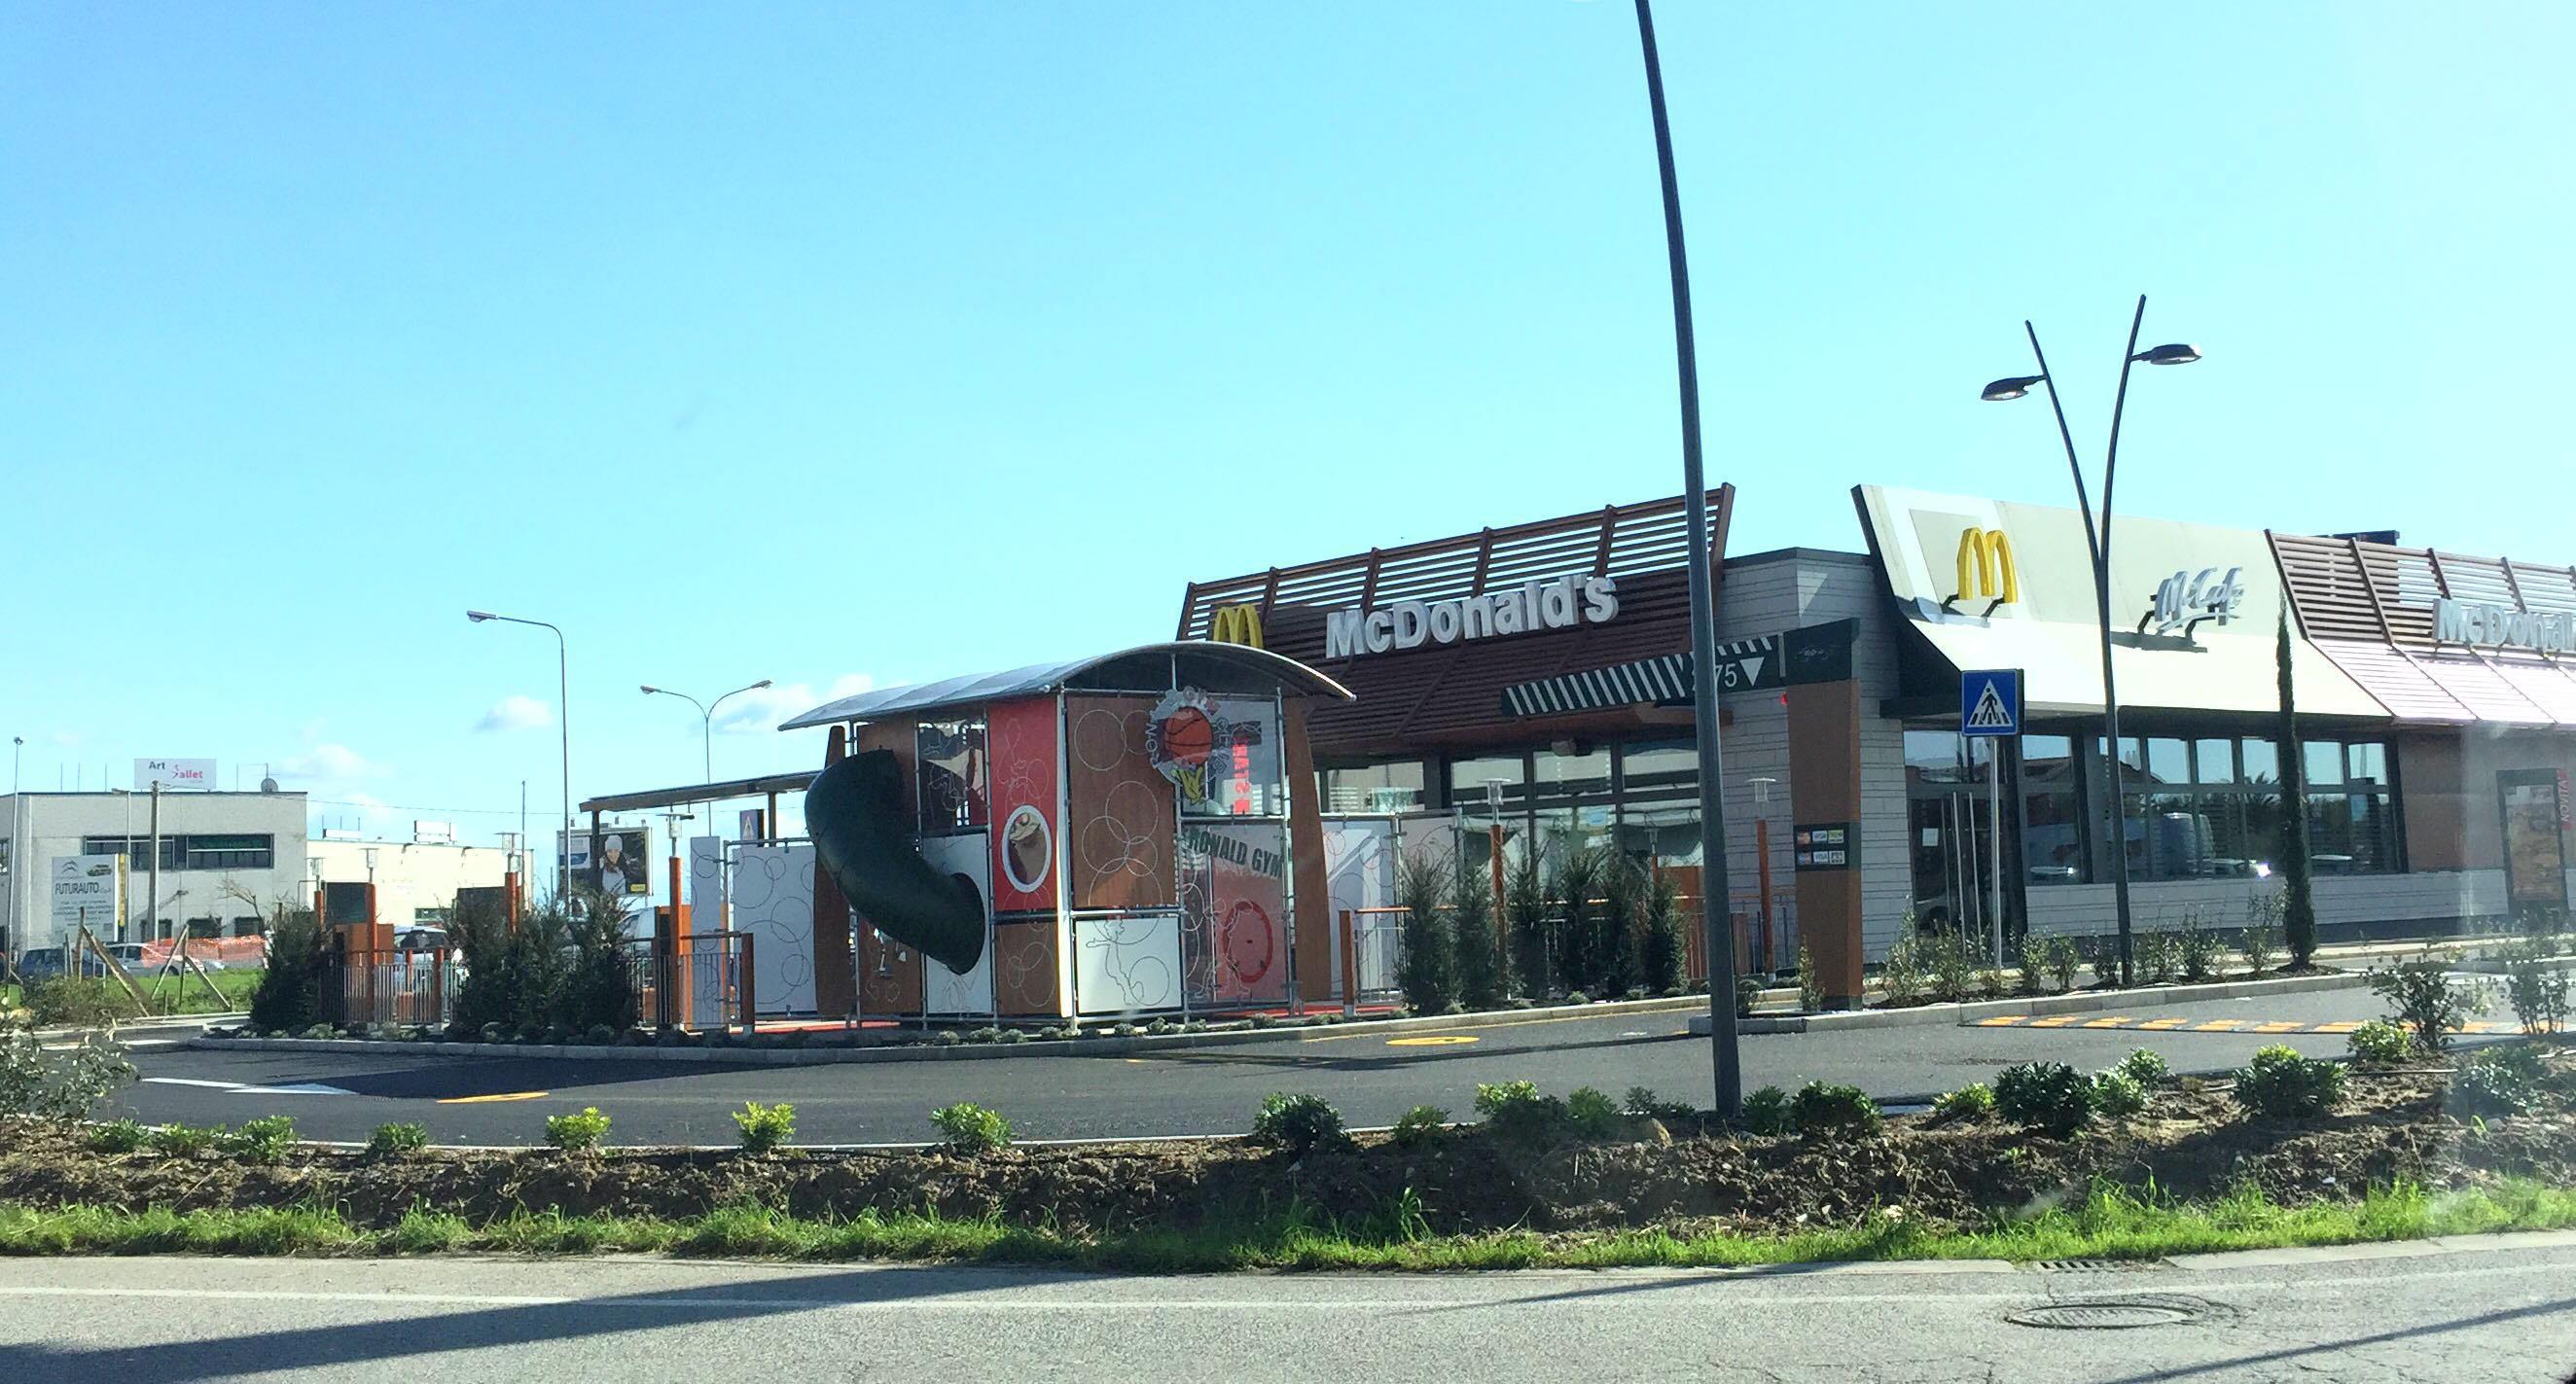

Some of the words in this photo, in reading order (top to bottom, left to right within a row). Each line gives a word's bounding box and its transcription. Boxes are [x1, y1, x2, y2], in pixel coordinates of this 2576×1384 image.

[1325, 574, 1620, 659] McDonald's
[149, 761, 165, 770] Art
[54, 881, 100, 895] FUTURAUTO
